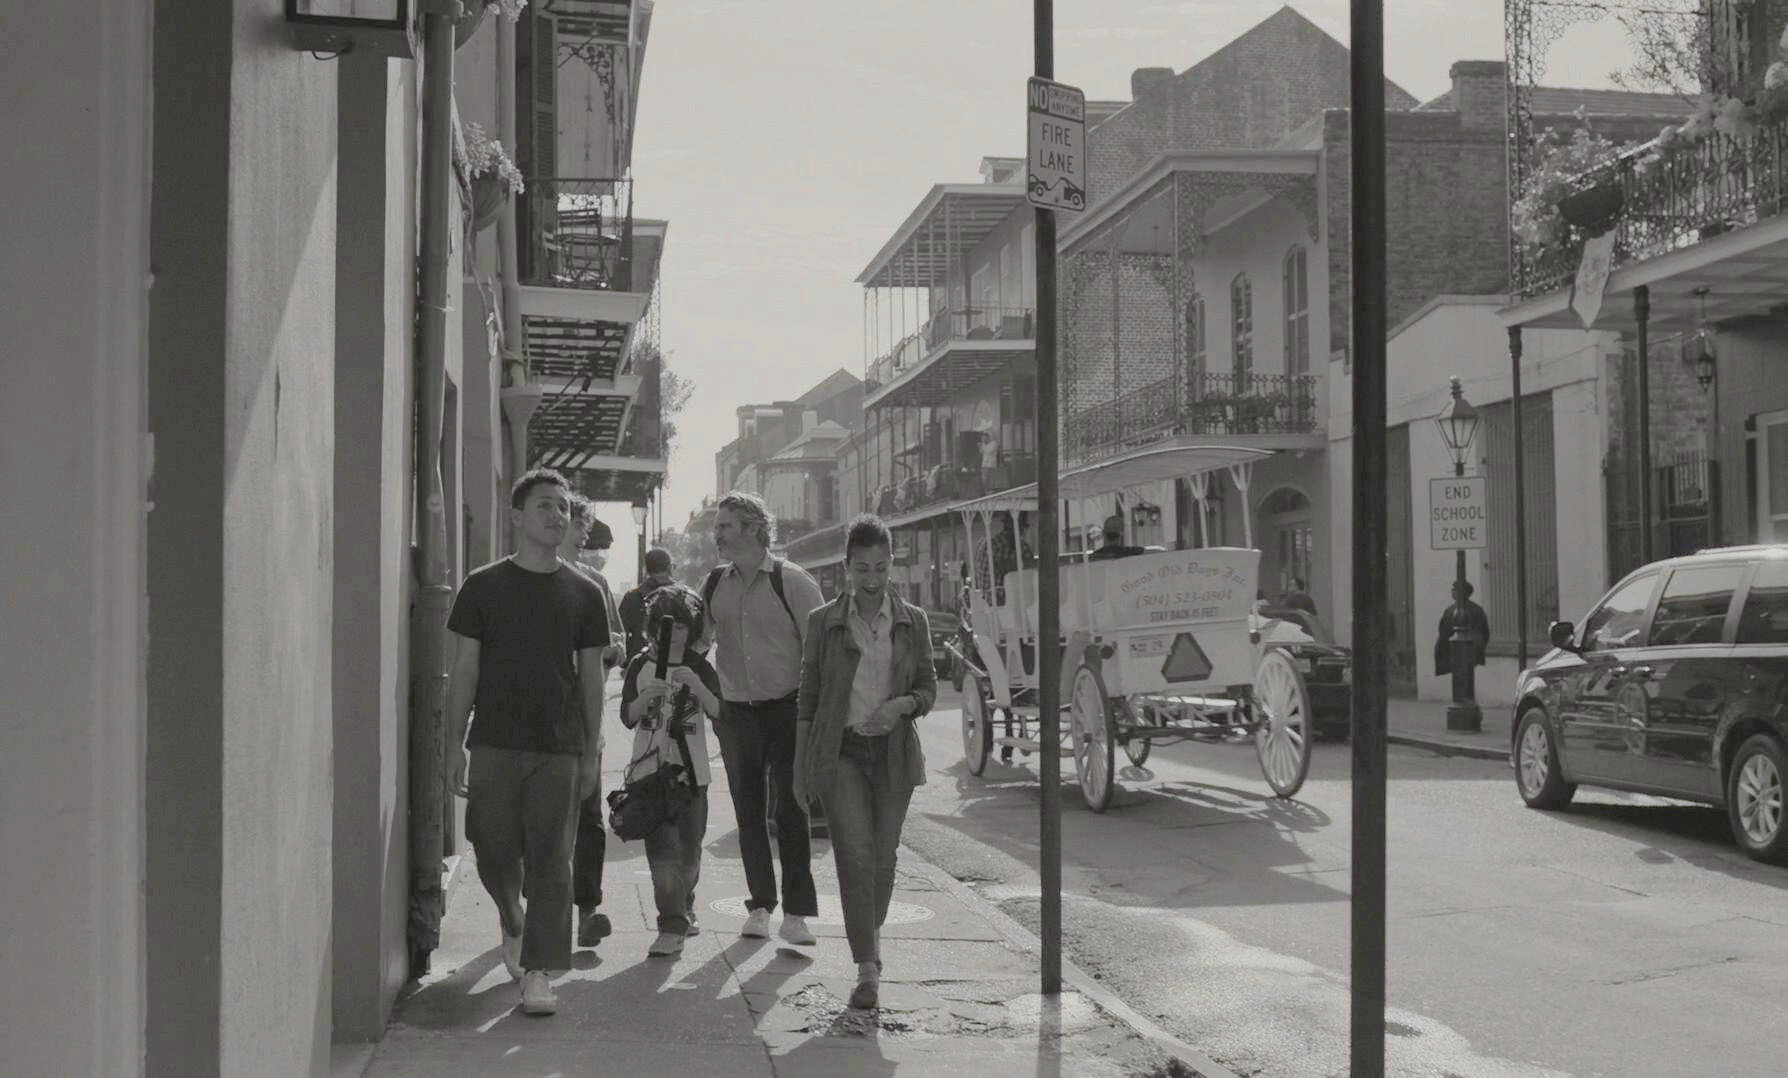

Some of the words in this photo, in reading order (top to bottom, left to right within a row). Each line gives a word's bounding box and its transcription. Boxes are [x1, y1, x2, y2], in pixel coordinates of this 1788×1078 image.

[1030, 83, 1048, 111] NO
[1041, 123, 1072, 147] FIRE
[1039, 149, 1074, 174] LANE
[1445, 486, 1471, 500] END
[1433, 506, 1484, 521] SCHOOL
[1441, 527, 1477, 542] ZONE
[1157, 565, 1182, 578] Old
[1187, 561, 1219, 577] Days
[1150, 611, 1169, 622] STAY
[1170, 609, 1189, 620] BACK
[1201, 606, 1219, 617] FEET
